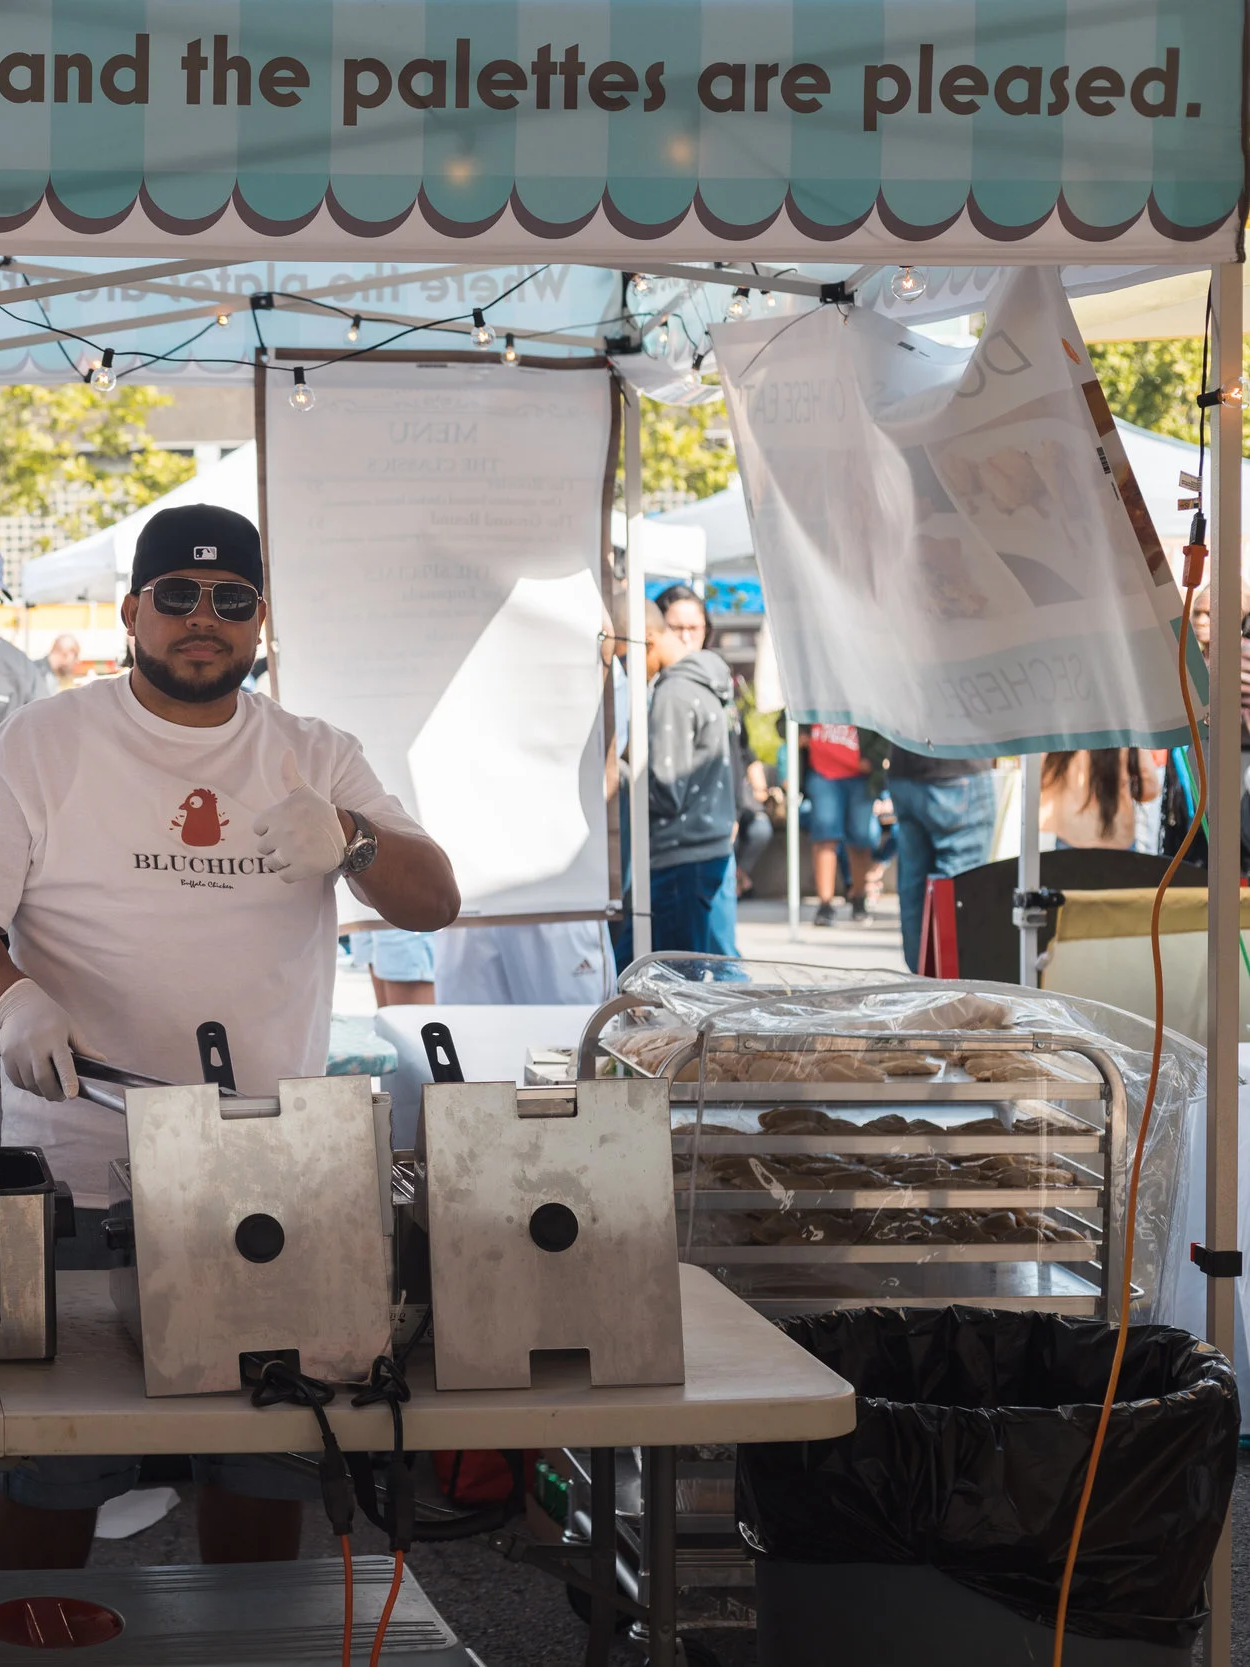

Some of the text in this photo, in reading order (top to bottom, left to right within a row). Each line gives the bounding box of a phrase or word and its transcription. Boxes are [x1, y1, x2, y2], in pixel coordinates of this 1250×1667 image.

[180, 34, 311, 108] the
[342, 37, 667, 127] palettes
[696, 61, 832, 115] are
[862, 43, 1202, 131] pleased.
[180, 878, 234, 890] Buffalo Chicken
